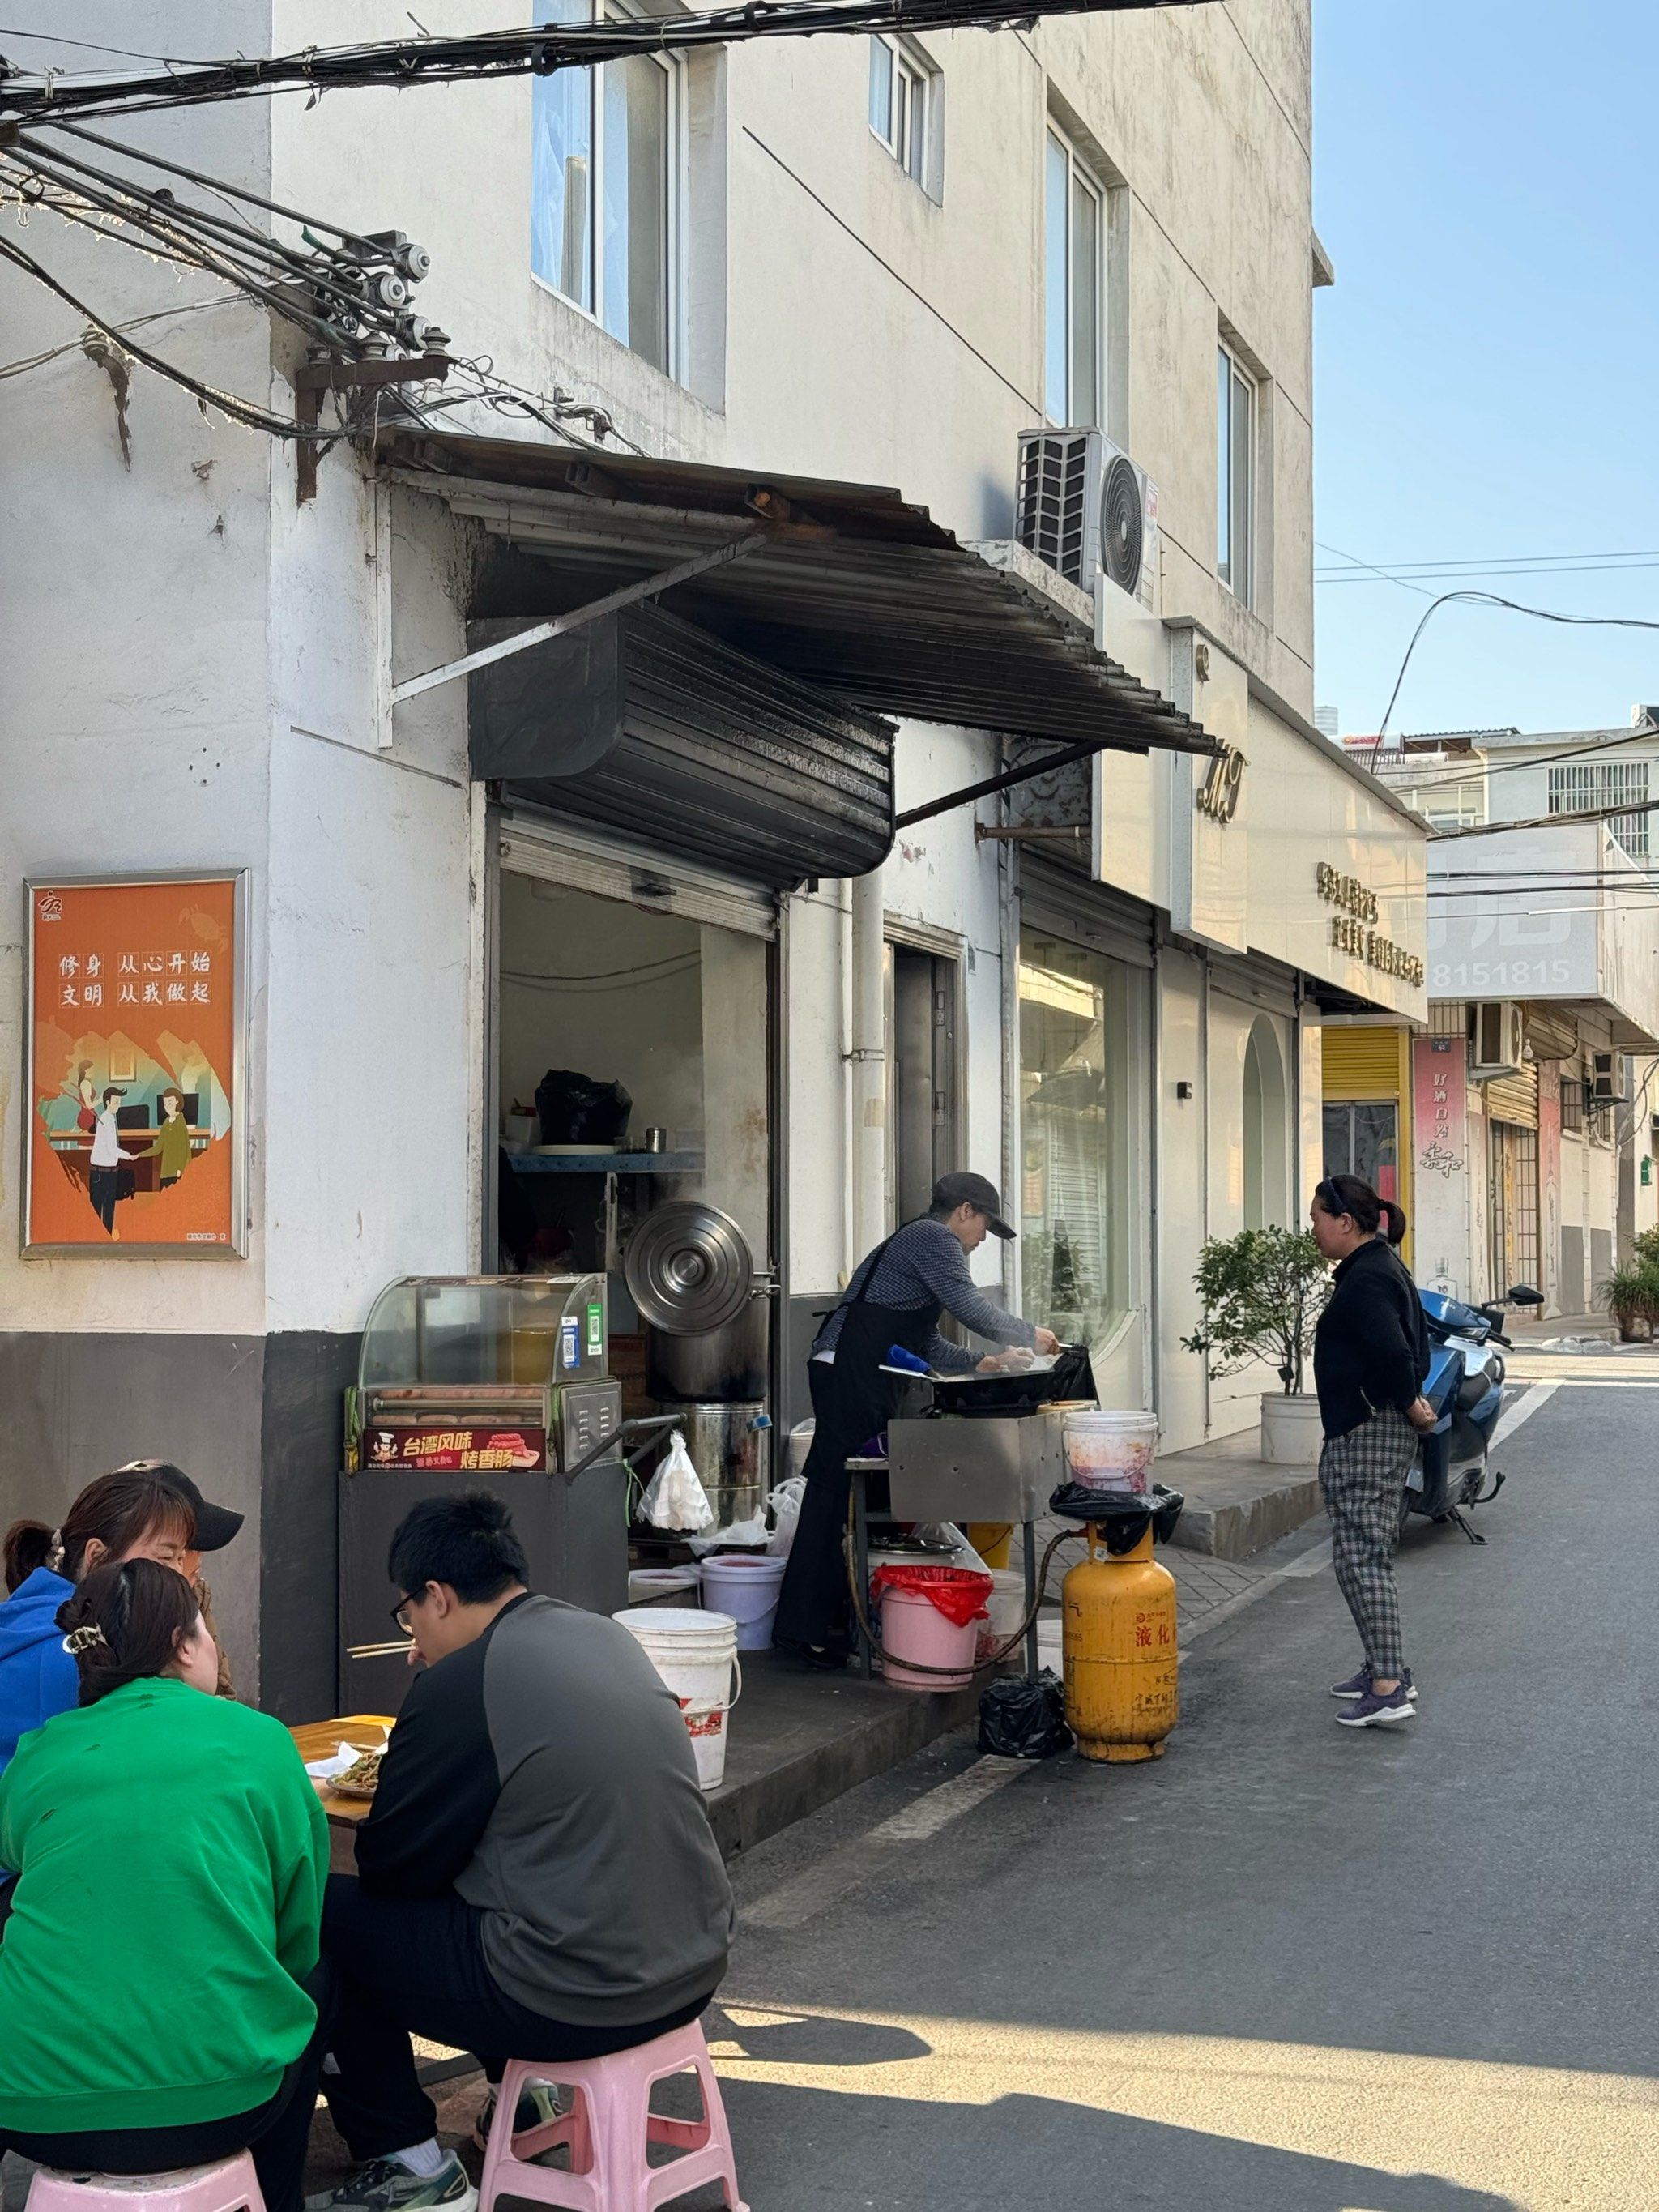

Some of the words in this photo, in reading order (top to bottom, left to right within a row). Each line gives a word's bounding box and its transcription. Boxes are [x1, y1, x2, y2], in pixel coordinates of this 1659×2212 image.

[60, 954, 101, 978] 修身
[118, 951, 211, 975] 从心开始
[61, 984, 103, 1006] 文明
[118, 981, 211, 1006] 从我做起
[403, 1431, 473, 1457] 台湾风味
[460, 1450, 514, 1469] 烤香肠
[1136, 1623, 1176, 1646] 液化
